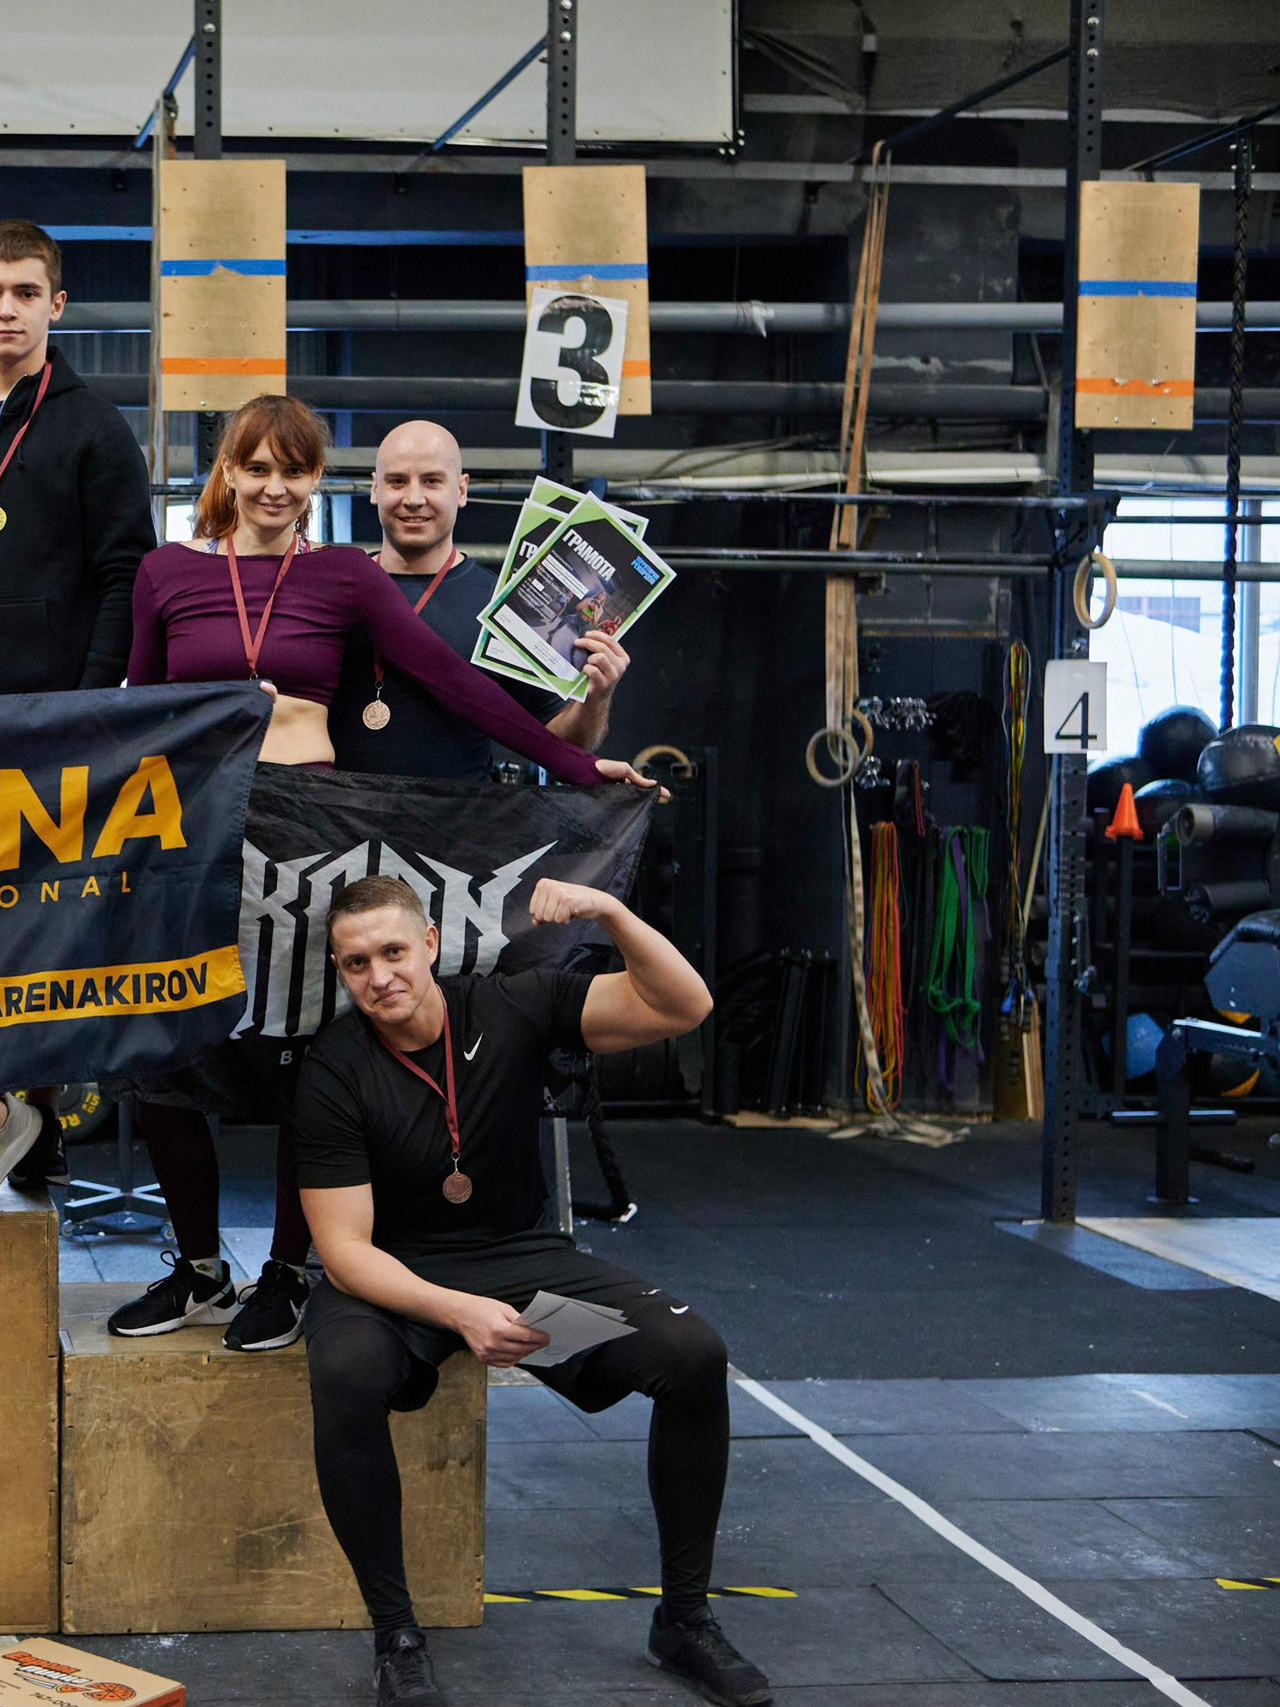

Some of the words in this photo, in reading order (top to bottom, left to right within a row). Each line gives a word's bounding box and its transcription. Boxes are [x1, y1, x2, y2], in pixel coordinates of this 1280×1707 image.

[529, 295, 614, 429] 3
[562, 528, 617, 582] ГРАМОТА
[1055, 692, 1098, 750] 4
